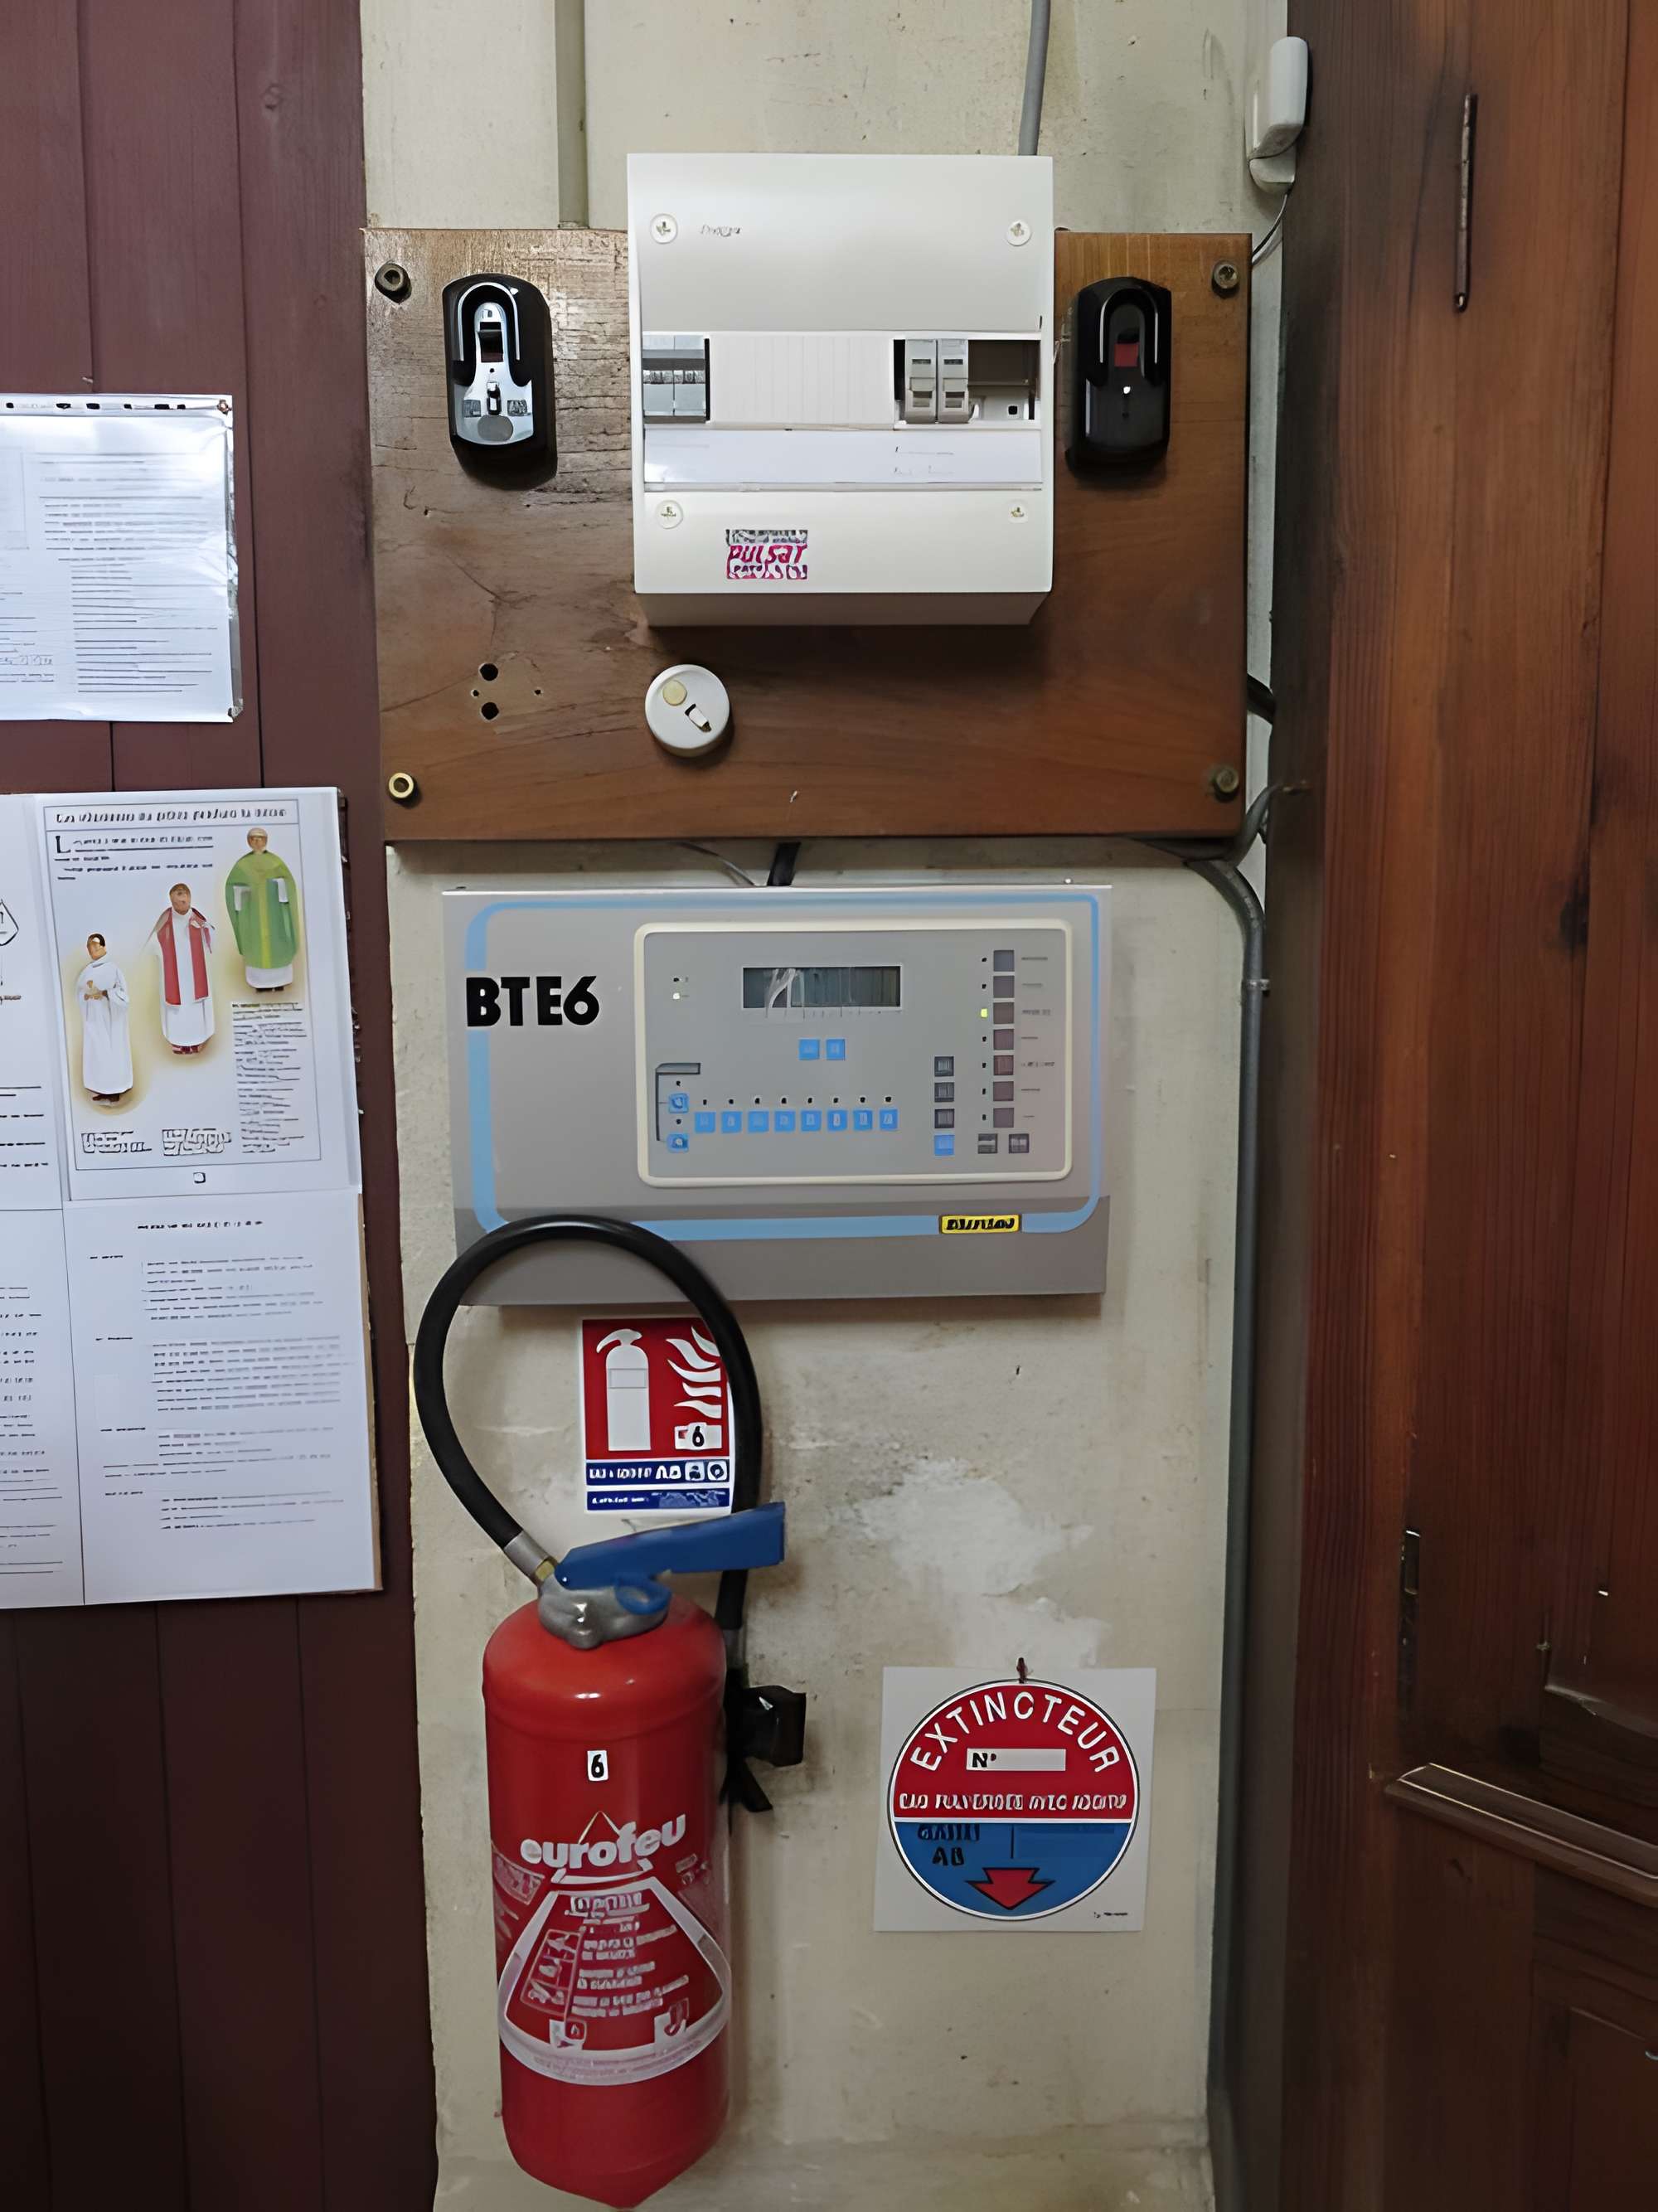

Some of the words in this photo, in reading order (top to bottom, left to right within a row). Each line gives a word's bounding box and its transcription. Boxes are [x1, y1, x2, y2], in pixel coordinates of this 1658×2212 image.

[466, 976, 599, 1027] BTE6
[910, 1691, 1120, 1772] EXTINCTEUR
[591, 1753, 604, 1779] 6
[521, 1813, 686, 1869] eurofeu
